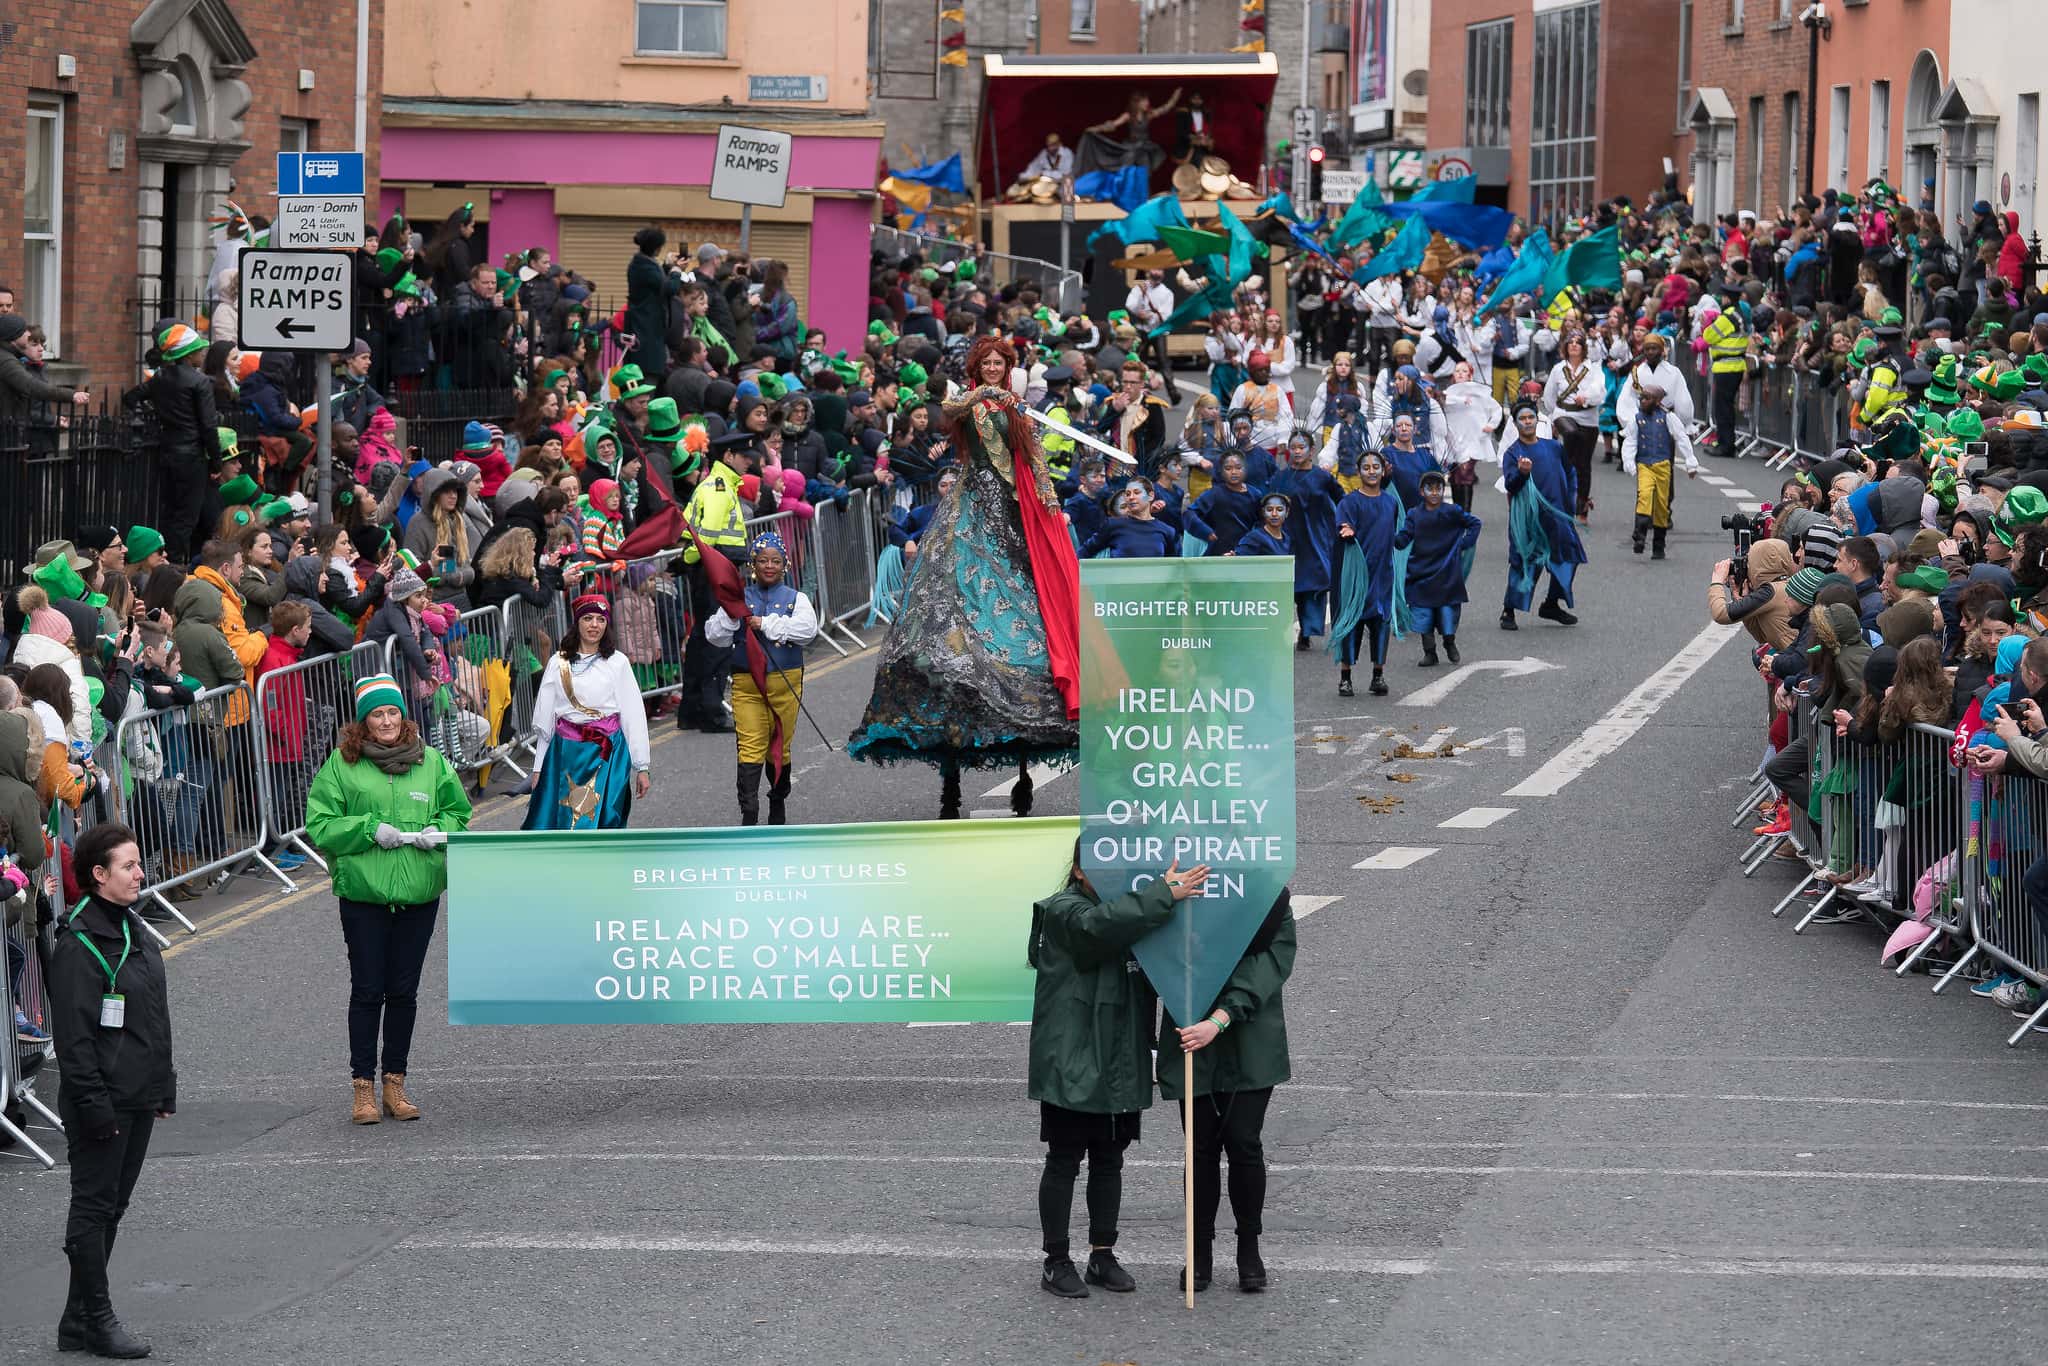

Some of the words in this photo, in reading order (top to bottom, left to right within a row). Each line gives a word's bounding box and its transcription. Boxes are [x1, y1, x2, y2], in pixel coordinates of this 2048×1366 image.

[725, 154, 779, 173] RAMPS
[1445, 167, 1463, 180] 50
[300, 218, 316, 230] 24
[289, 232, 320, 243] MON
[329, 231, 355, 243] SUN
[250, 288, 343, 311] RAMPS
[1094, 601, 1188, 617] BRIGHTER
[1195, 601, 1280, 616] FUTURES
[1161, 638, 1211, 649] DUBLIN
[1119, 688, 1255, 713] IRELAND
[1104, 725, 1172, 750] YOU
[1183, 725, 1270, 750] ARE...
[1132, 762, 1242, 787] GRACE
[1106, 799, 1269, 825] O'MALLEY
[1093, 836, 1163, 862] OUR
[1174, 836, 1282, 861] PIRATE
[632, 866, 771, 884] BRIGHTER
[785, 862, 907, 880] FUTURES
[735, 889, 808, 903] DUBLIN
[595, 917, 750, 942] IRELAND
[767, 916, 841, 939] YOU
[858, 915, 950, 939] ARE...
[612, 945, 736, 970] GRACE
[752, 943, 934, 969] O'MALLEY
[595, 975, 671, 1000] OUR
[689, 974, 811, 1000] PIRATE
[827, 973, 952, 1003] QUEEN
